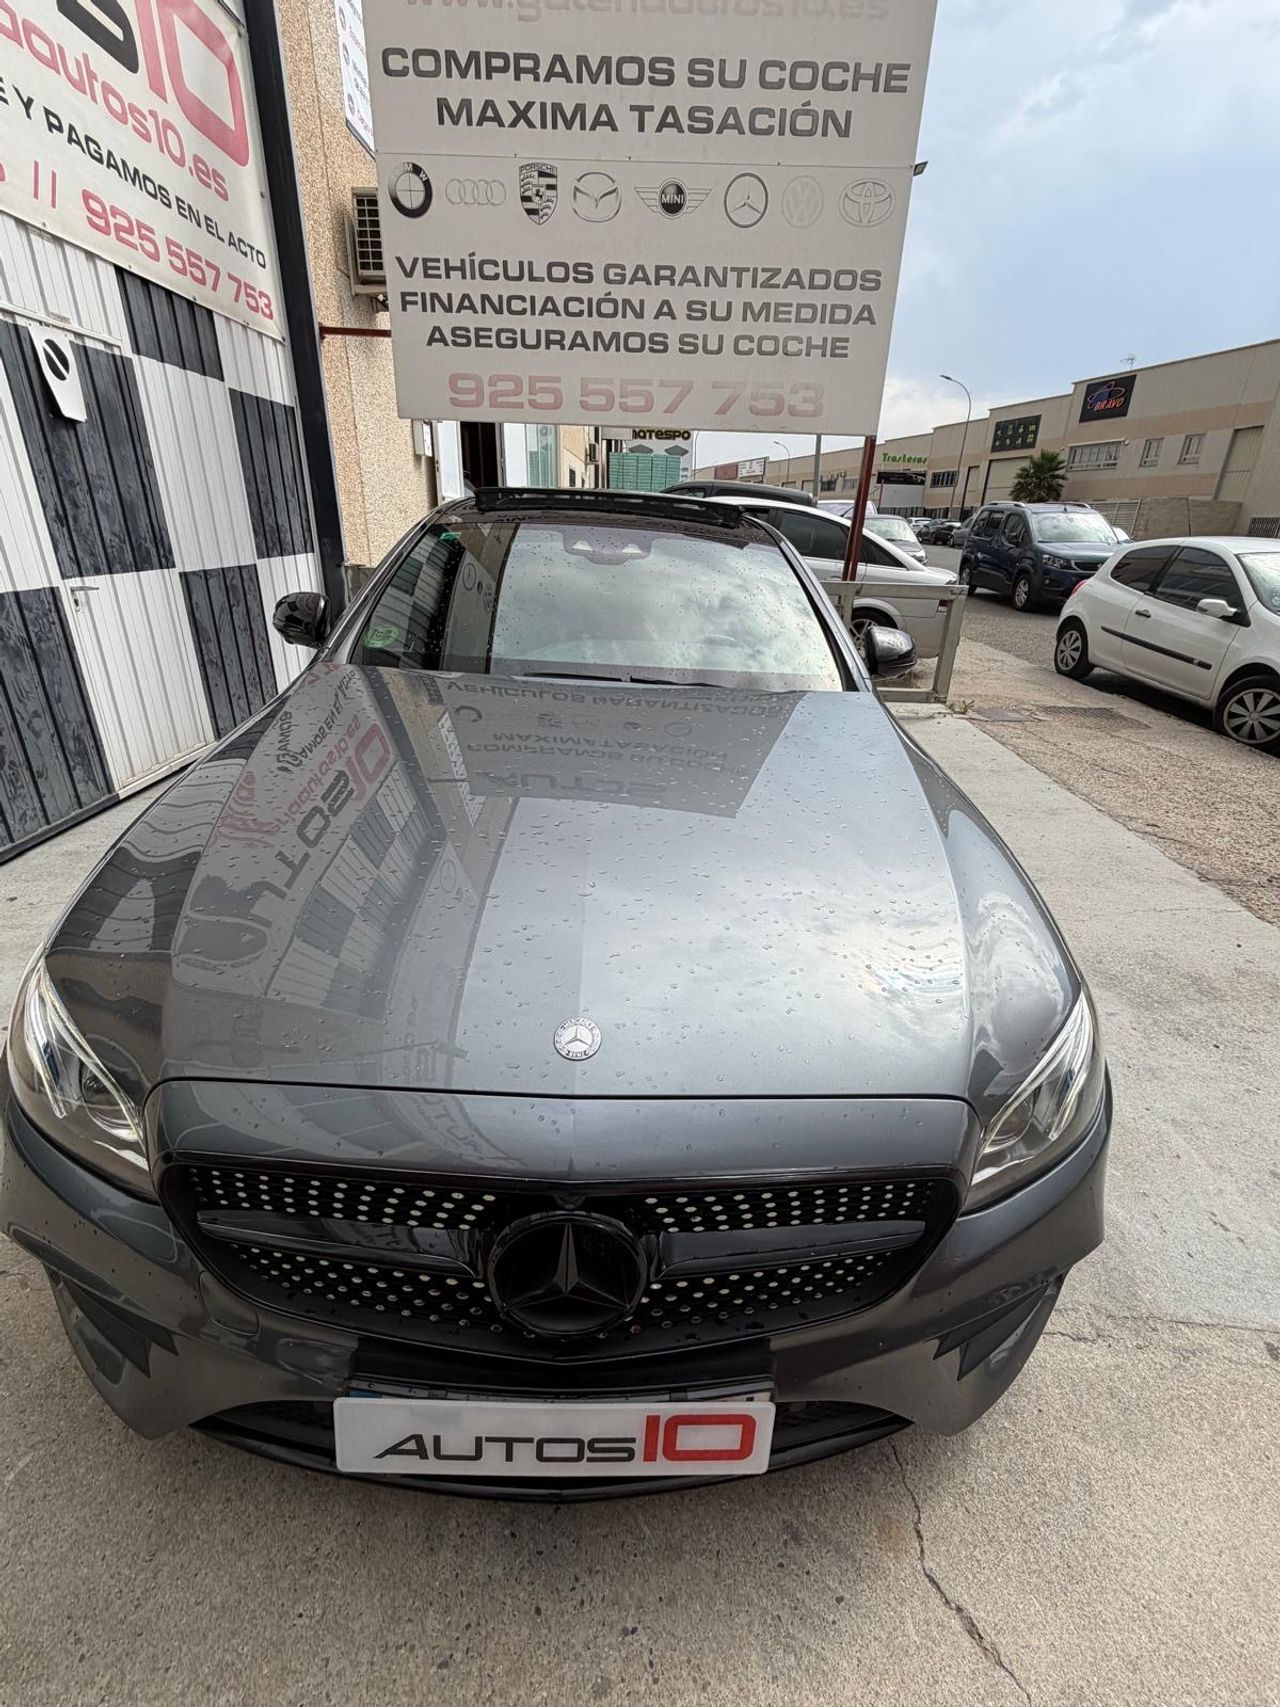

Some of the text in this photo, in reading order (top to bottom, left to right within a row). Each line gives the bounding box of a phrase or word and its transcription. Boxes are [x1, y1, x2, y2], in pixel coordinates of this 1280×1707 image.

[381, 47, 676, 87] COMPRAMOS
[687, 57, 747, 89] SU
[758, 60, 911, 93] COCHE
[436, 97, 852, 138] MAXIMA TASACIÓN
[13, 84, 34, 120] Y
[43, 106, 172, 209] PAGAMOS
[175, 195, 201, 229] EN
[204, 214, 225, 243] EL
[228, 231, 266, 269] ACTO
[661, 194, 684, 205] MINI
[82, 189, 160, 262] 925
[165, 235, 221, 292] 557
[227, 272, 273, 320] 753
[395, 252, 882, 292] VEHÍCULOS GARANTIZADOS
[400, 291, 876, 326] FINANCIACIÓN A SU MEDIDA
[426, 325, 850, 358] ASEGURAMOS SU COCHE
[448, 373, 825, 417] 925 557 753
[1094, 397, 1125, 411] BRAVO
[882, 452, 928, 464] Trasteros
